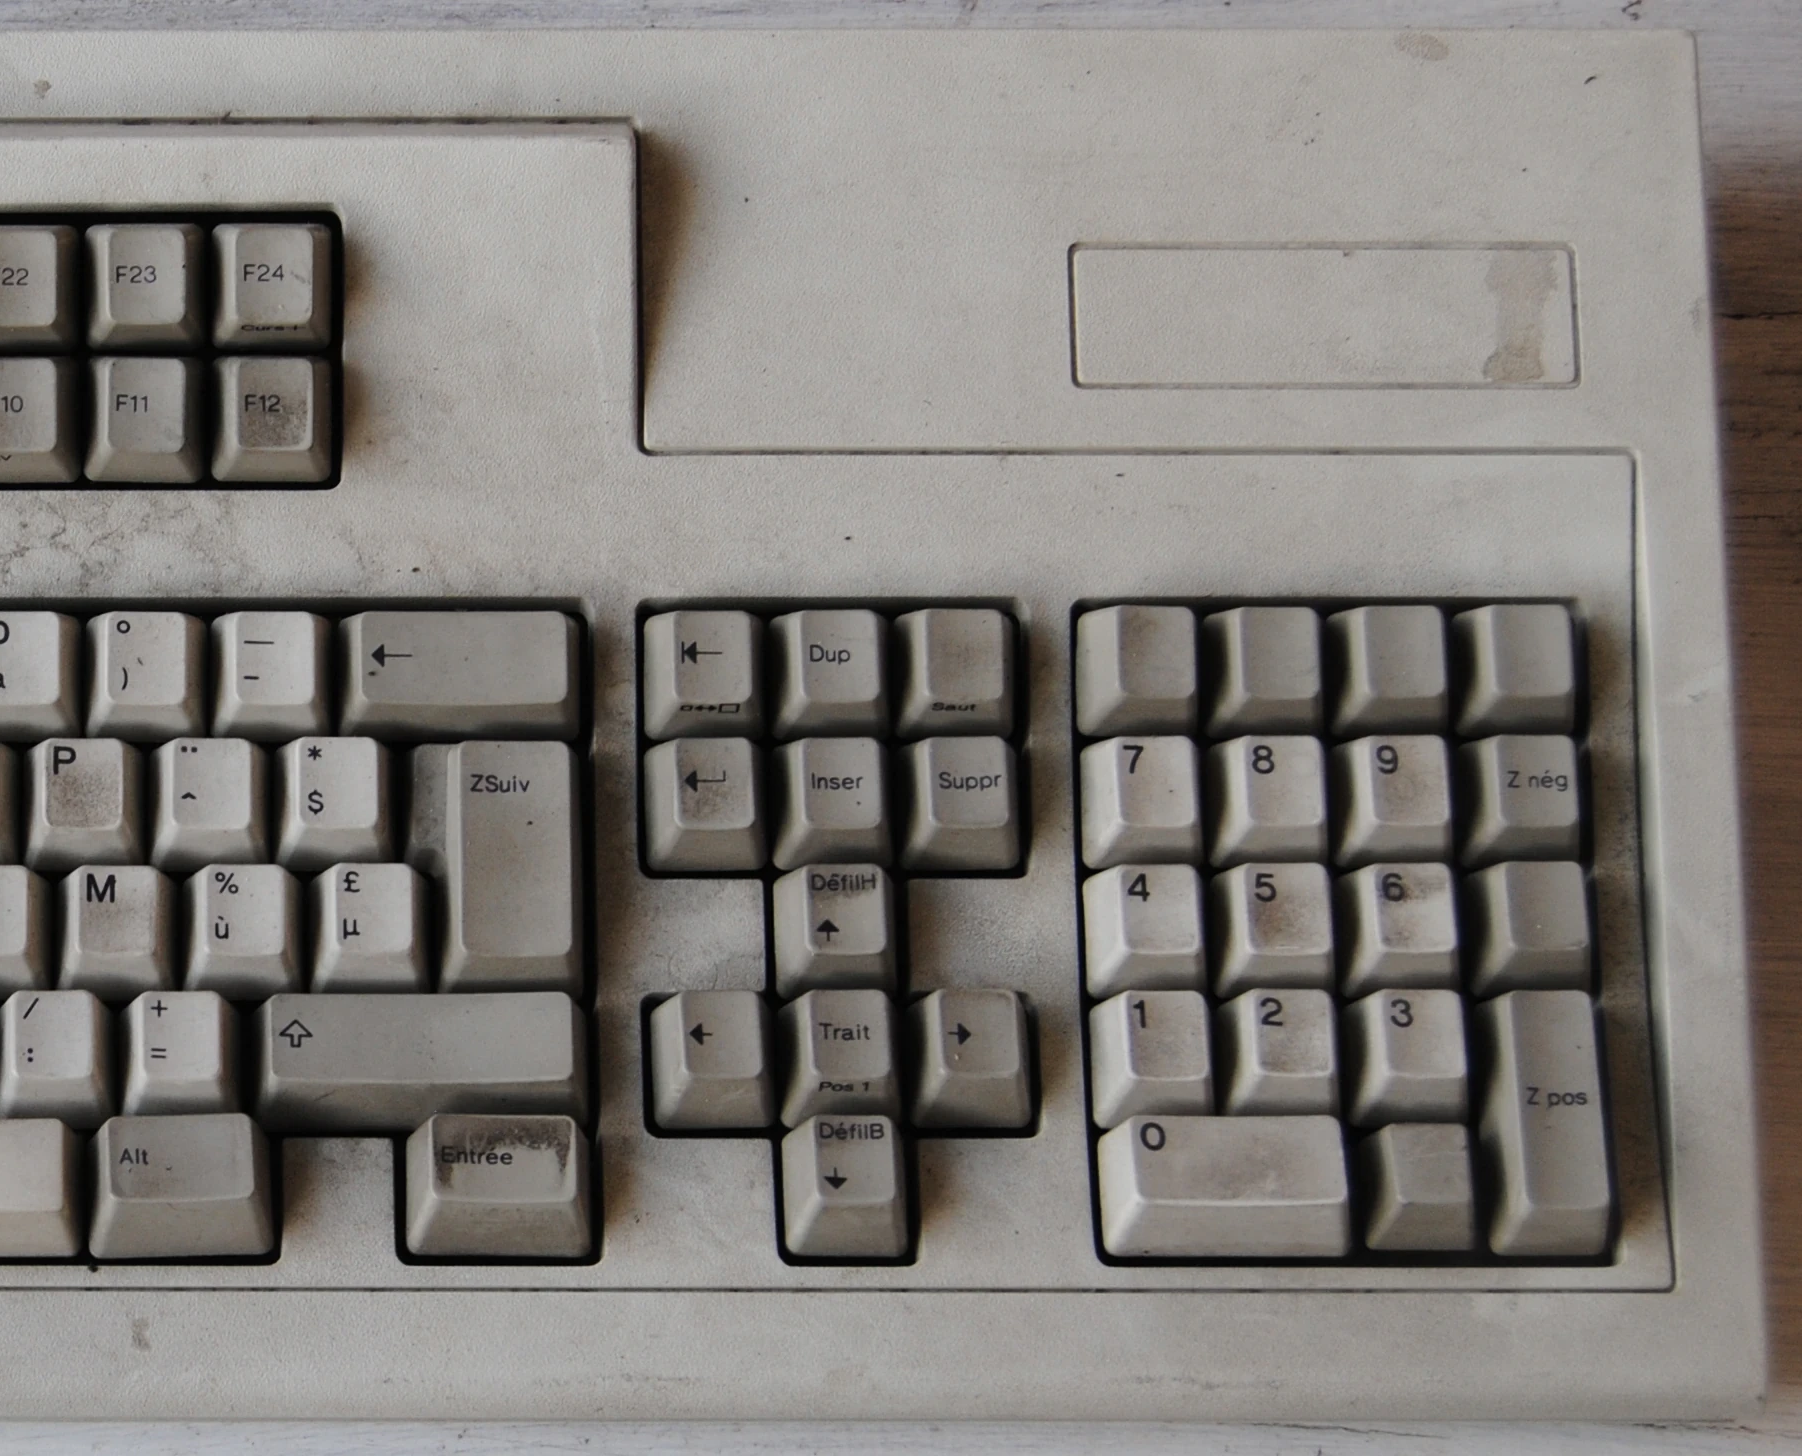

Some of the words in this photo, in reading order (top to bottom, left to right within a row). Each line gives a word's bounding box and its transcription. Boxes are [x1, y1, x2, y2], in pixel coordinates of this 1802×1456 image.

[116, 266, 156, 283] F23
[244, 264, 284, 281] F24
[116, 394, 147, 412] F11
[245, 394, 281, 413] F12
[810, 644, 850, 665] Dup
[122, 668, 128, 690] )
[932, 702, 976, 711] Saut
[53, 746, 76, 775] P
[1123, 745, 1144, 774] 7
[1252, 745, 1274, 774] 8
[1377, 745, 1398, 774] 9
[470, 774, 529, 793] ZSuiv
[812, 773, 863, 790] Inser
[939, 772, 1001, 791] Suppr
[1508, 771, 1520, 788] Z
[1529, 770, 1568, 792] nég
[308, 790, 324, 815] $
[87, 873, 116, 903] M
[215, 872, 238, 894] %
[344, 871, 360, 892] £
[810, 873, 877, 892] DéfilH
[1128, 874, 1150, 901] 4
[1255, 873, 1276, 902] 5
[1382, 873, 1407, 901] 6
[215, 916, 229, 939] ù
[23, 998, 39, 1019] /
[151, 1000, 167, 1017] +
[1133, 1000, 1147, 1028] 1
[1260, 998, 1283, 1026] 2
[1391, 999, 1413, 1028] 3
[819, 1023, 870, 1041] Trait
[28, 1048, 33, 1062] :
[151, 1048, 166, 1058] =
[819, 1082, 853, 1091] Pos
[862, 1082, 869, 1091] 1
[1526, 1087, 1539, 1105] Z
[1548, 1092, 1588, 1107] pos
[820, 1123, 884, 1140] DéfilB
[1140, 1122, 1166, 1151] 0
[119, 1148, 148, 1165] Alt
[442, 1147, 513, 1165] Entrée
